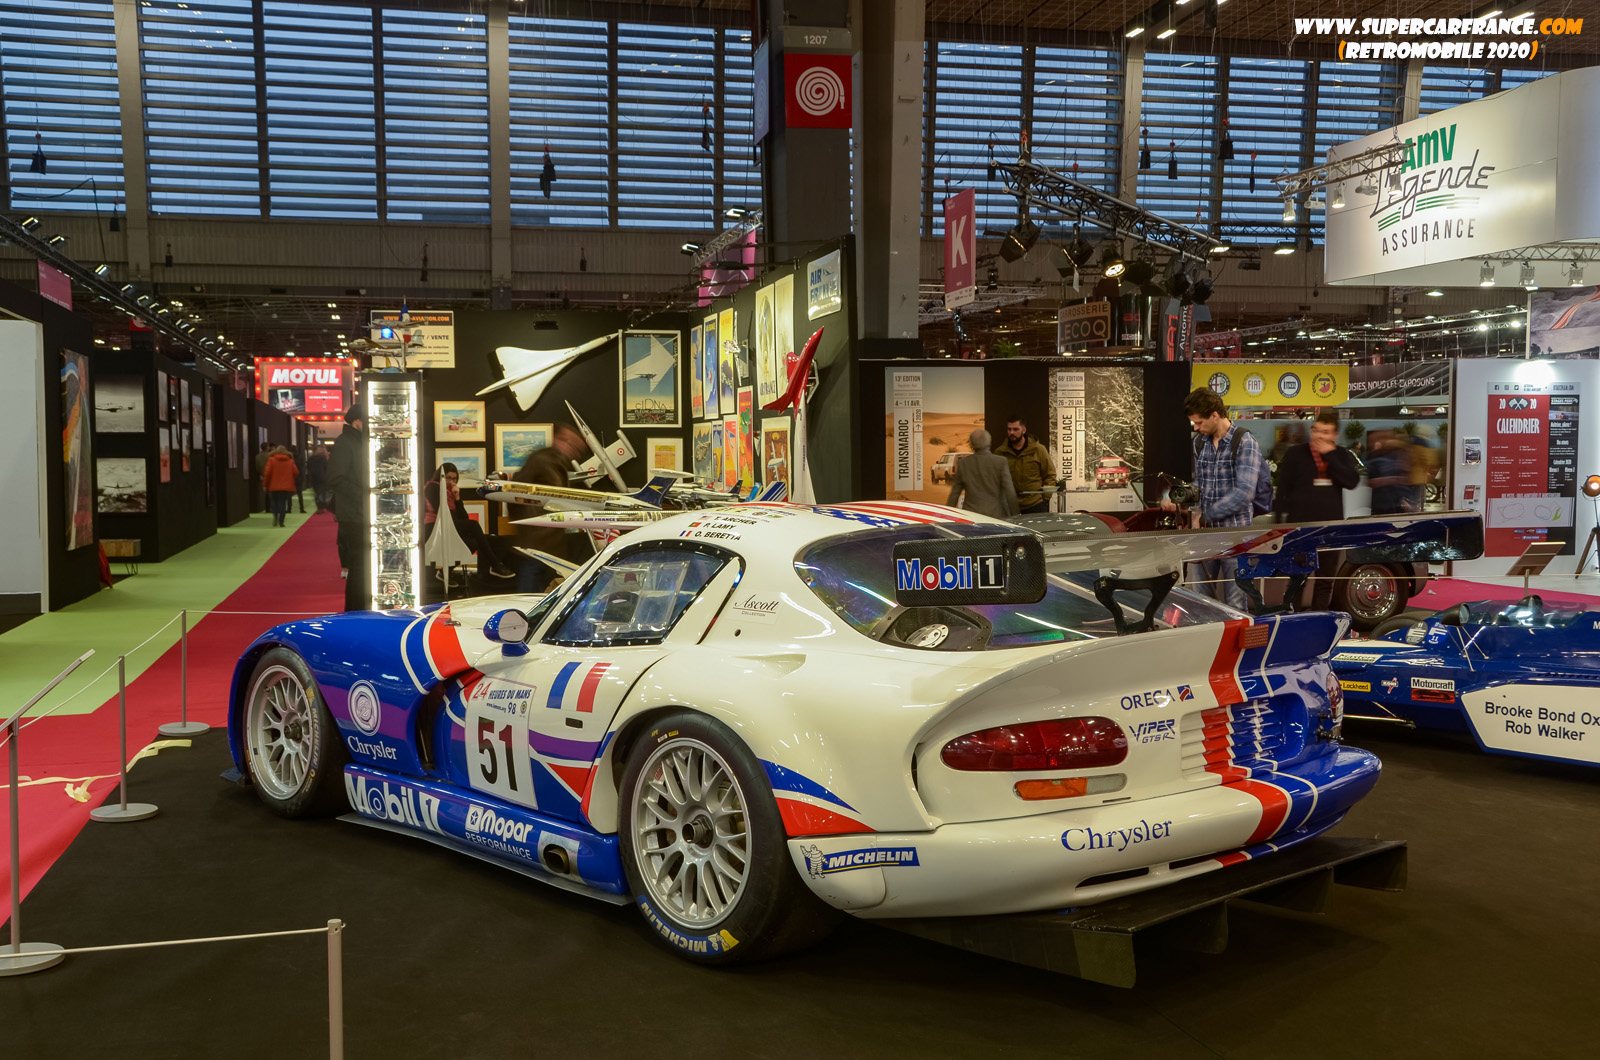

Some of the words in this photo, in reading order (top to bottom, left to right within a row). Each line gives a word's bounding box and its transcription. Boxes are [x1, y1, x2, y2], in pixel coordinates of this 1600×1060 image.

[804, 35, 828, 44] 1207
[952, 215, 968, 268] K
[1382, 218, 1476, 256] ASSURANCE
[810, 268, 822, 286] AIR
[271, 369, 339, 384] MOTUL
[1248, 380, 1261, 390] FIAT
[1499, 398, 1506, 409] 20
[1530, 398, 1536, 409] 20
[1062, 414, 1072, 442] GLACE
[1496, 418, 1540, 434] CALENDRIER
[899, 420, 909, 480] TRANSMAROC
[1062, 444, 1072, 454] ET
[1062, 456, 1072, 480] NEIGE
[897, 556, 972, 590] Mobil
[734, 594, 779, 611] Ascott
[473, 682, 492, 699] 24
[488, 690, 507, 699] HEURES
[507, 690, 515, 699] DU
[515, 689, 532, 699] MANS
[1413, 679, 1453, 690] Motorcraft
[508, 702, 516, 714] 98
[1485, 702, 1532, 719] Brooke
[1539, 707, 1575, 724] Bond
[1505, 721, 1531, 734] Rob
[1537, 724, 1585, 741] Walker
[347, 736, 397, 760] Chrysler
[478, 716, 518, 792] 51
[344, 773, 420, 828] Mobil
[480, 808, 533, 843] Mopar
[1061, 820, 1172, 852] Chrysler
[465, 832, 532, 860] PERFORMANCE
[828, 850, 914, 868] MICHELIN
[641, 901, 708, 952] MICHELIN
